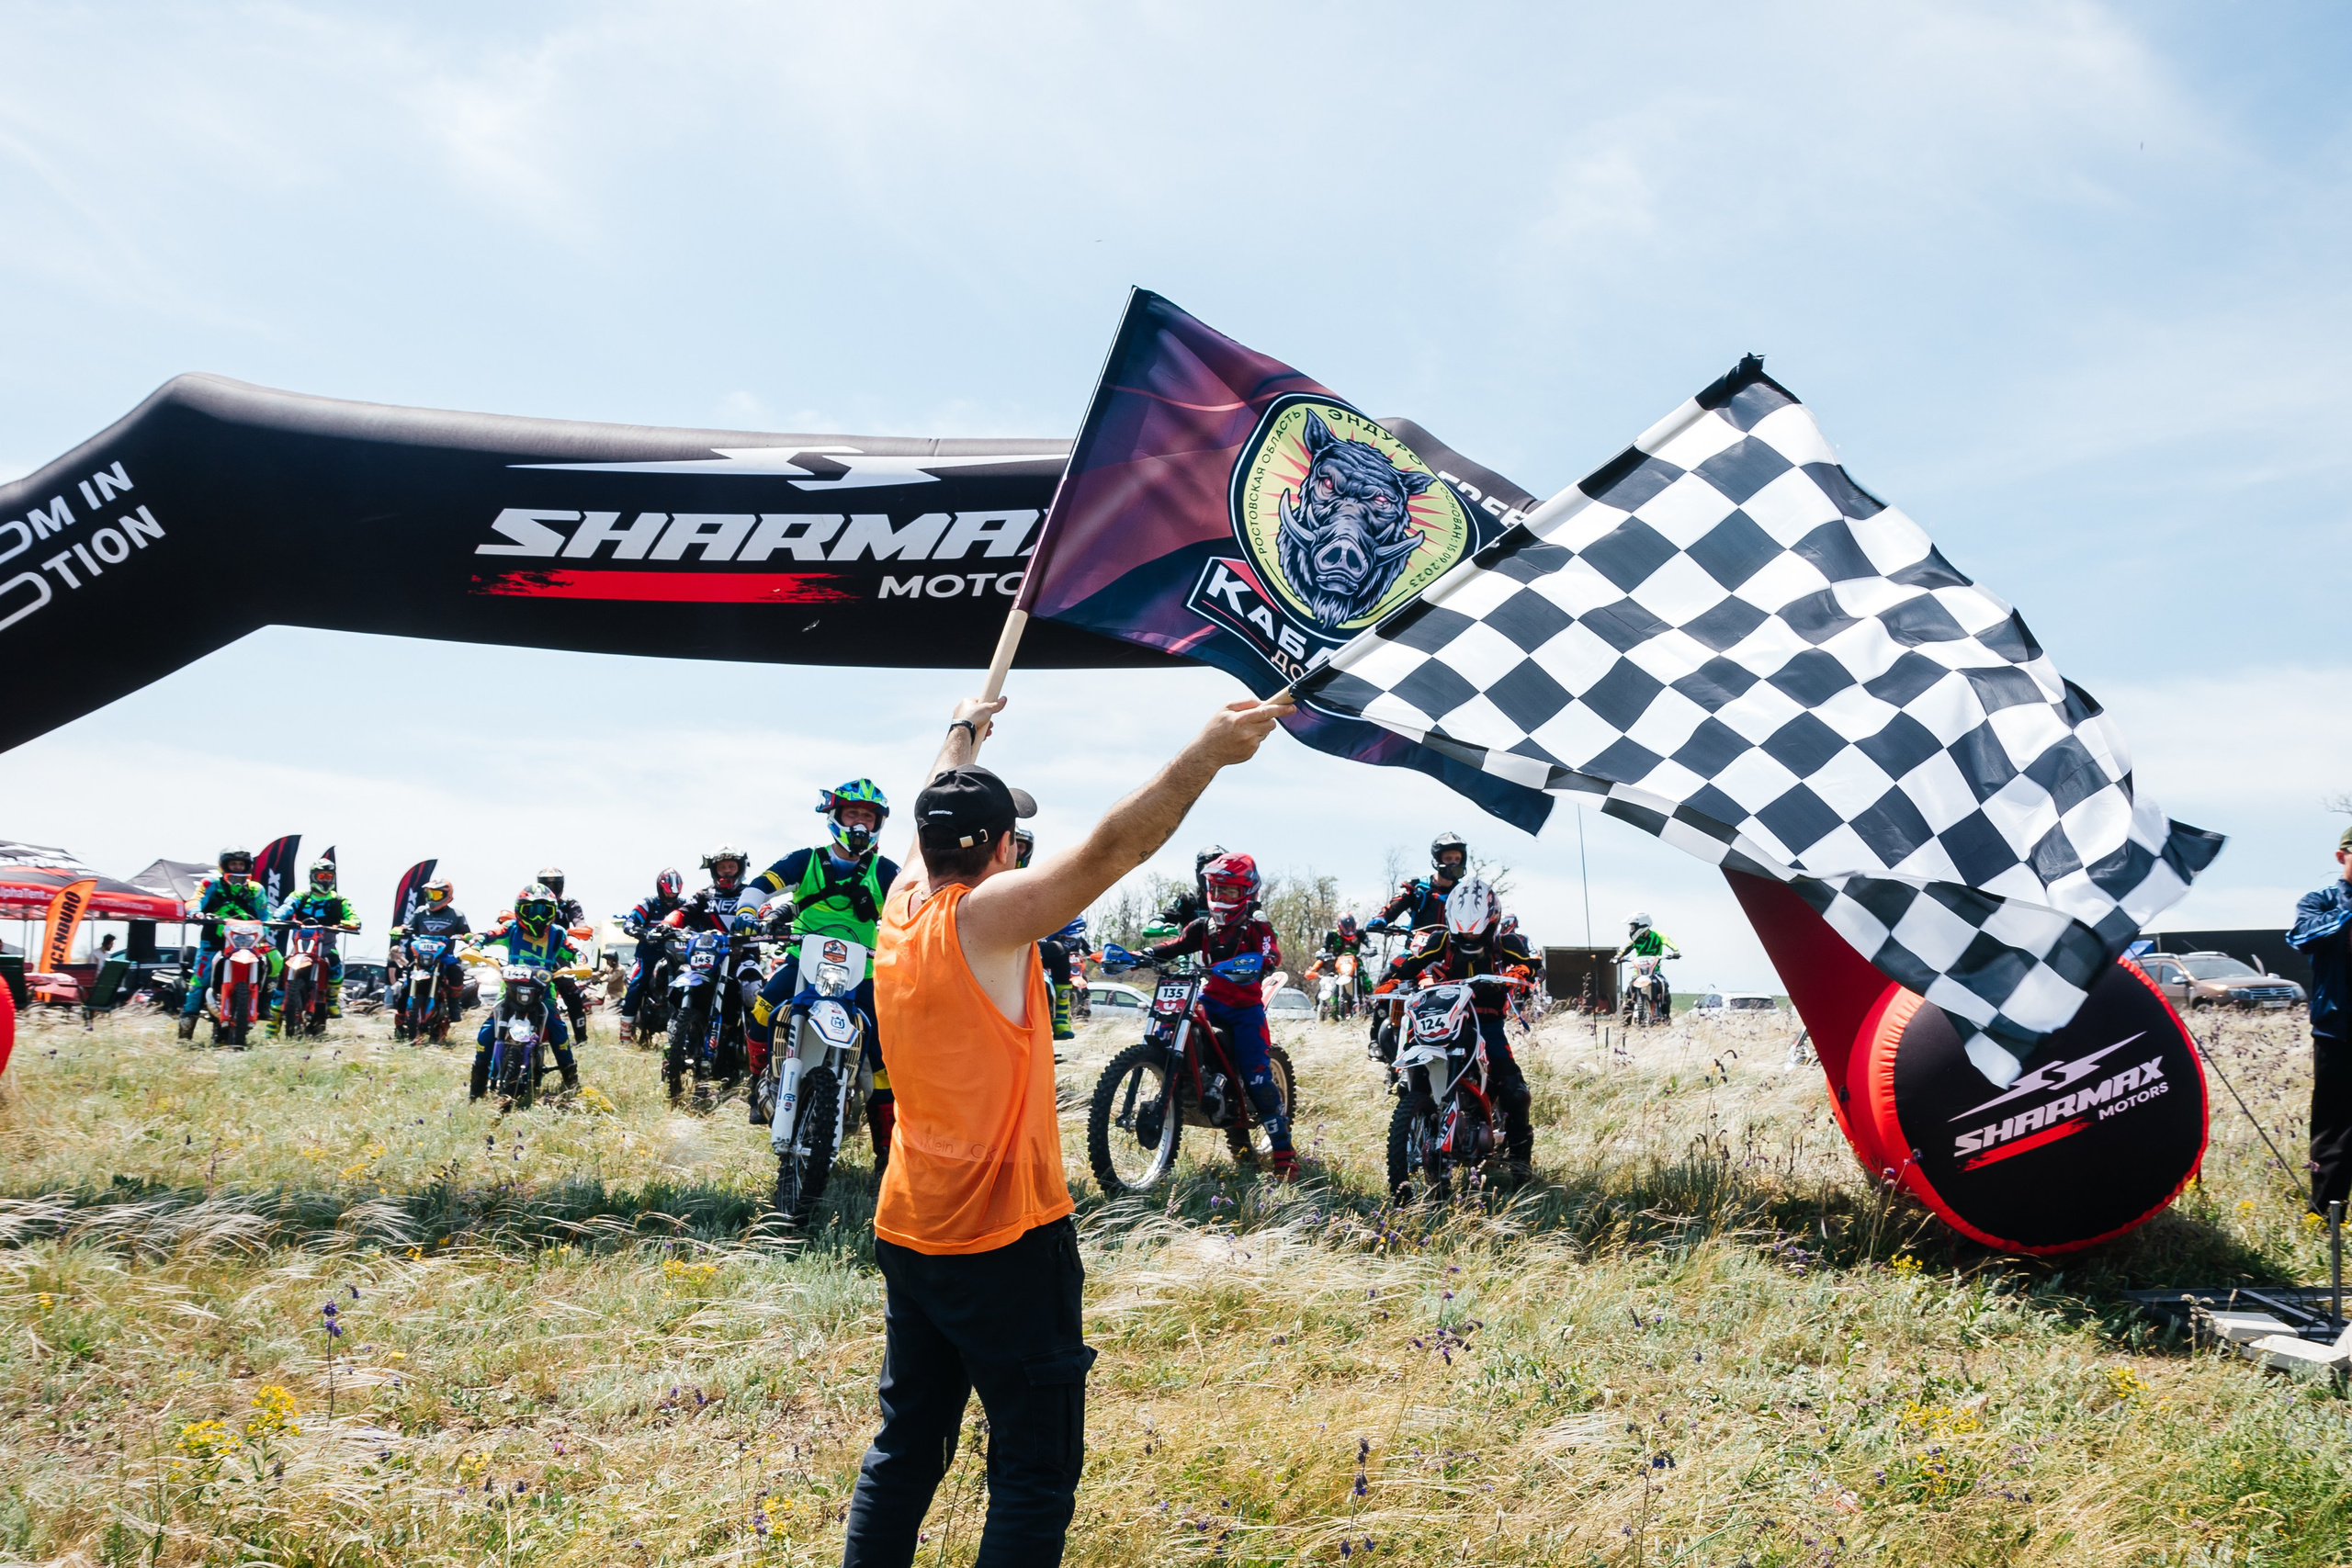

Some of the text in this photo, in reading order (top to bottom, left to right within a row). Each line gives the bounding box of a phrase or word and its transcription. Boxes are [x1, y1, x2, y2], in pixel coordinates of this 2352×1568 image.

[1328, 409, 1423, 466] ЭНДУРО
[78, 460, 134, 511] IN
[1249, 410, 1301, 555] РОСТОВСКАЯ ОБЛАСТЬ
[474, 508, 1049, 560] SHARMA
[1408, 486, 1463, 587] ОСНОВАН: 15.09.2023
[507, 969, 527, 978] 144
[695, 955, 711, 964] 145
[1163, 987, 1183, 998] 135
[1420, 1017, 1445, 1031] 124
[1953, 1055, 2165, 1157] SHARMAX
[2098, 1081, 2169, 1120] MOTORS
